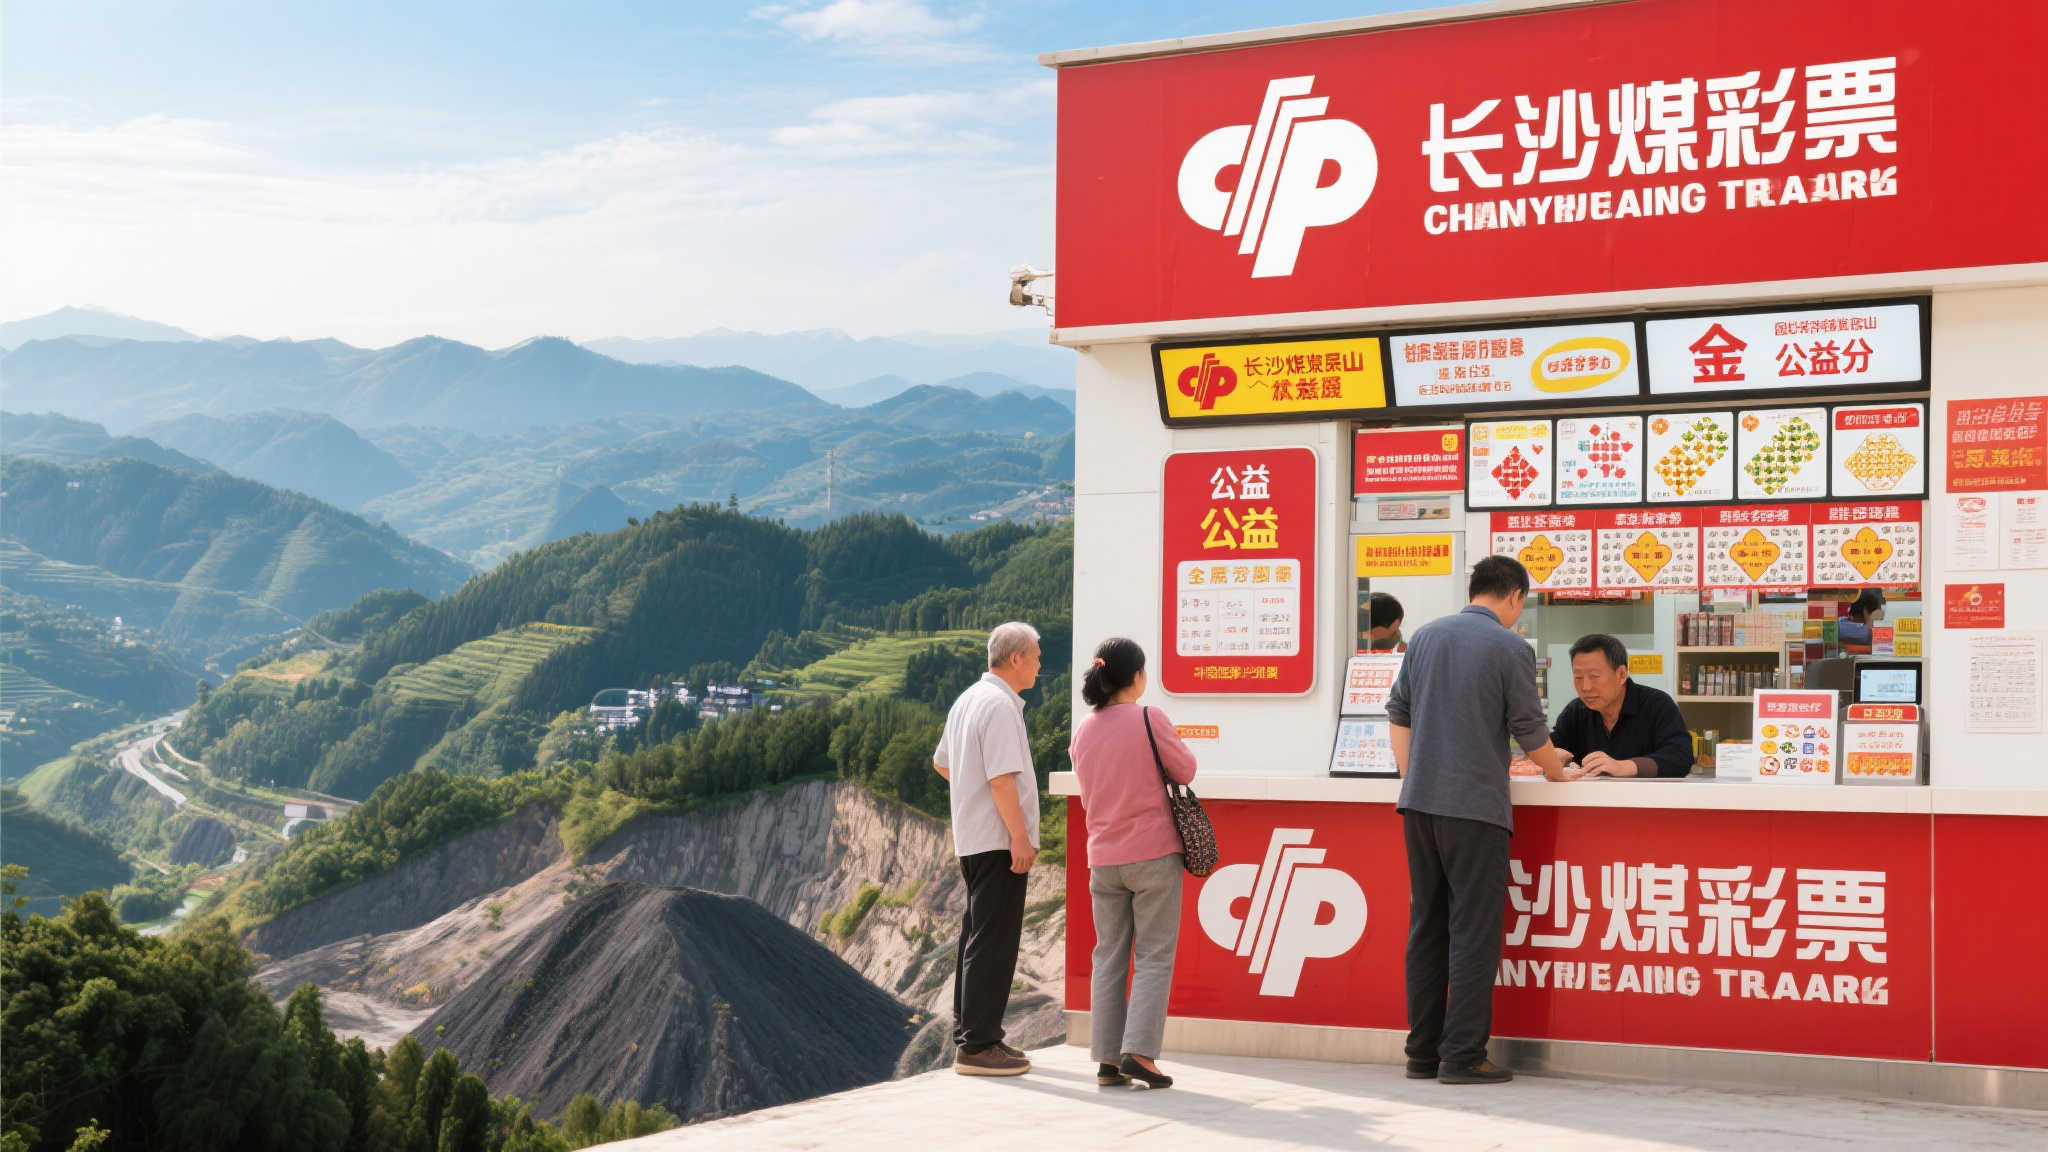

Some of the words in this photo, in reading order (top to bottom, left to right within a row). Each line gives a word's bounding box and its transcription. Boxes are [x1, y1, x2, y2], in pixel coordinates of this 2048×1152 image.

[1421, 56, 1898, 194] 长沙煤彩票
[1688, 322, 1748, 384] 金
[1775, 337, 1875, 378] 公益分
[1209, 463, 1271, 501] 公益
[1200, 506, 1280, 551] 公益
